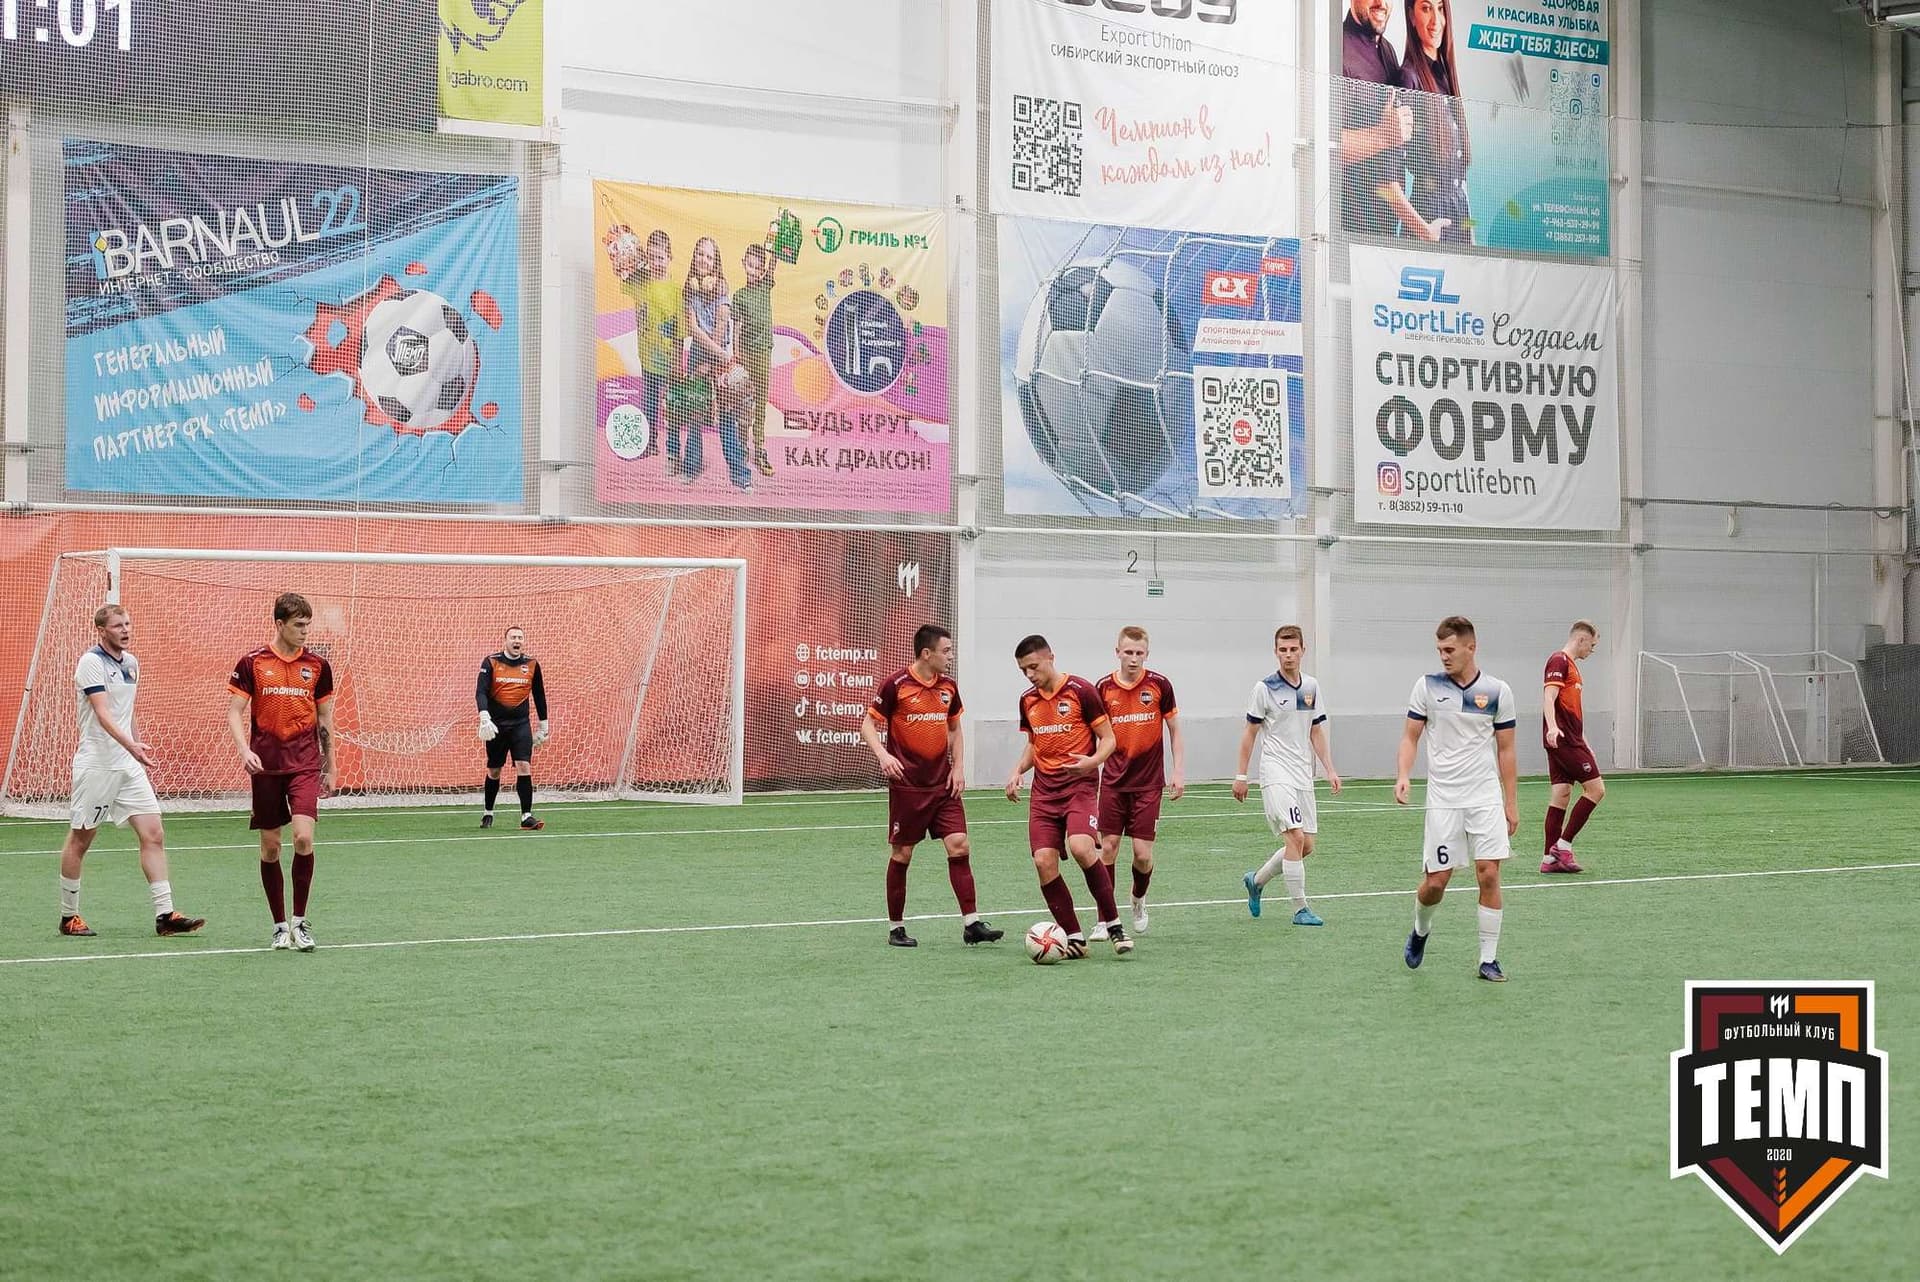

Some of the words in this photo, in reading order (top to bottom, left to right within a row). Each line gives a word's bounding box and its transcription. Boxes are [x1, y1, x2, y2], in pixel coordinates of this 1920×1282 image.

[1487, 6, 1495, 19] И
[1497, 8, 1555, 27] КРАСИВАЯ
[1557, 15, 1600, 33] УЛЫБКА
[1101, 24, 1149, 47] Export
[1151, 31, 1192, 53] Union
[1478, 30, 1517, 51] ЖДЕТ
[1519, 34, 1552, 54] ТЕБЯ
[1553, 39, 1600, 60] ЗДЕСЬ!
[1050, 43, 1122, 66] СИБИРСКИЙ
[1126, 53, 1206, 75] ЭКСПОРТНЫЙ
[1208, 63, 1240, 78] СОЮЗ
[1200, 154, 1226, 184] из
[1230, 132, 1272, 170] нас!
[849, 230, 900, 248] ГРИЛЬ
[904, 234, 929, 249] №1
[98, 270, 173, 295] ИНТЕРНЕТ
[183, 250, 280, 280] СООБЩЕСТВО
[1396, 265, 1461, 304] SL
[1202, 326, 1251, 338] СПОРТИВНАЯ
[1373, 303, 1486, 338] SportLife
[1491, 311, 1603, 360] Создаем
[92, 324, 227, 377] ГЕНЕРАЛЬНЫЙ
[93, 354, 275, 422] ИНФОРМАЦИОННЫЙ
[1375, 351, 1597, 398] СПОРТИВНУЮ
[93, 422, 177, 463] ПАРТНЕР
[182, 413, 215, 442] ФК
[218, 401, 289, 436] «ТЕМП»
[783, 410, 853, 437] БУДЬ
[858, 412, 919, 439] КРУТ,
[1376, 395, 1597, 466] ФОРМУ
[783, 446, 831, 469] КАК
[834, 448, 933, 475] ДРАКОН!
[1404, 466, 1537, 498] sportlifebrn
[1389, 499, 1426, 514] 8(3852)
[1427, 502, 1464, 514] 59-11-10
[1127, 549, 1138, 574] 2
[815, 645, 878, 664] fctemp.ru
[815, 671, 837, 688] ФК
[838, 672, 874, 688] Темп
[815, 700, 865, 718] fc.temp
[92, 805, 110, 824] 77
[1289, 806, 1303, 824] 18
[1436, 845, 1449, 864] 6
